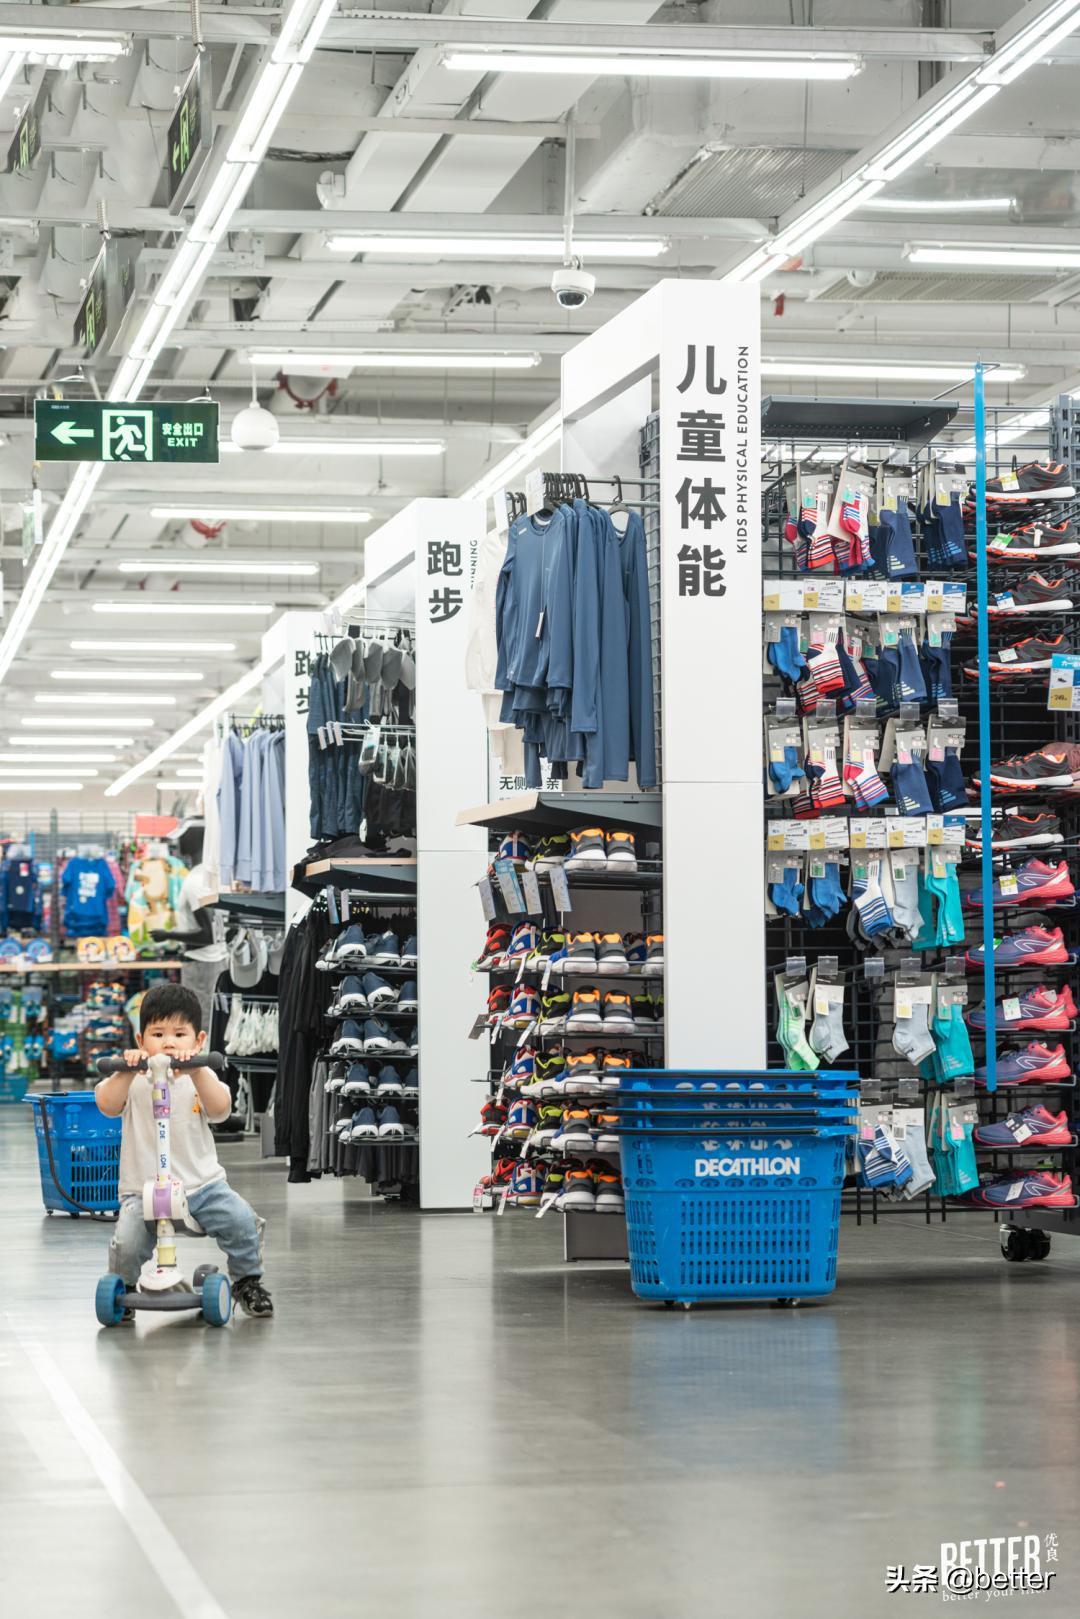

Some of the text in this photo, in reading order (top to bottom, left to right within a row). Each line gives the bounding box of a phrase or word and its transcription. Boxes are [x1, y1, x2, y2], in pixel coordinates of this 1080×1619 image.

[162, 422, 204, 436] 安全出口
[167, 438, 198, 447] EXIT
[736, 346, 749, 553] KIDS PHYSICAL EDUCATION
[675, 344, 728, 597] 儿童体能
[427, 540, 463, 624] 跑步
[470, 540, 478, 590] NNING
[499, 776, 560, 790] 无侧亲
[695, 1157, 800, 1177] DECATHLON
